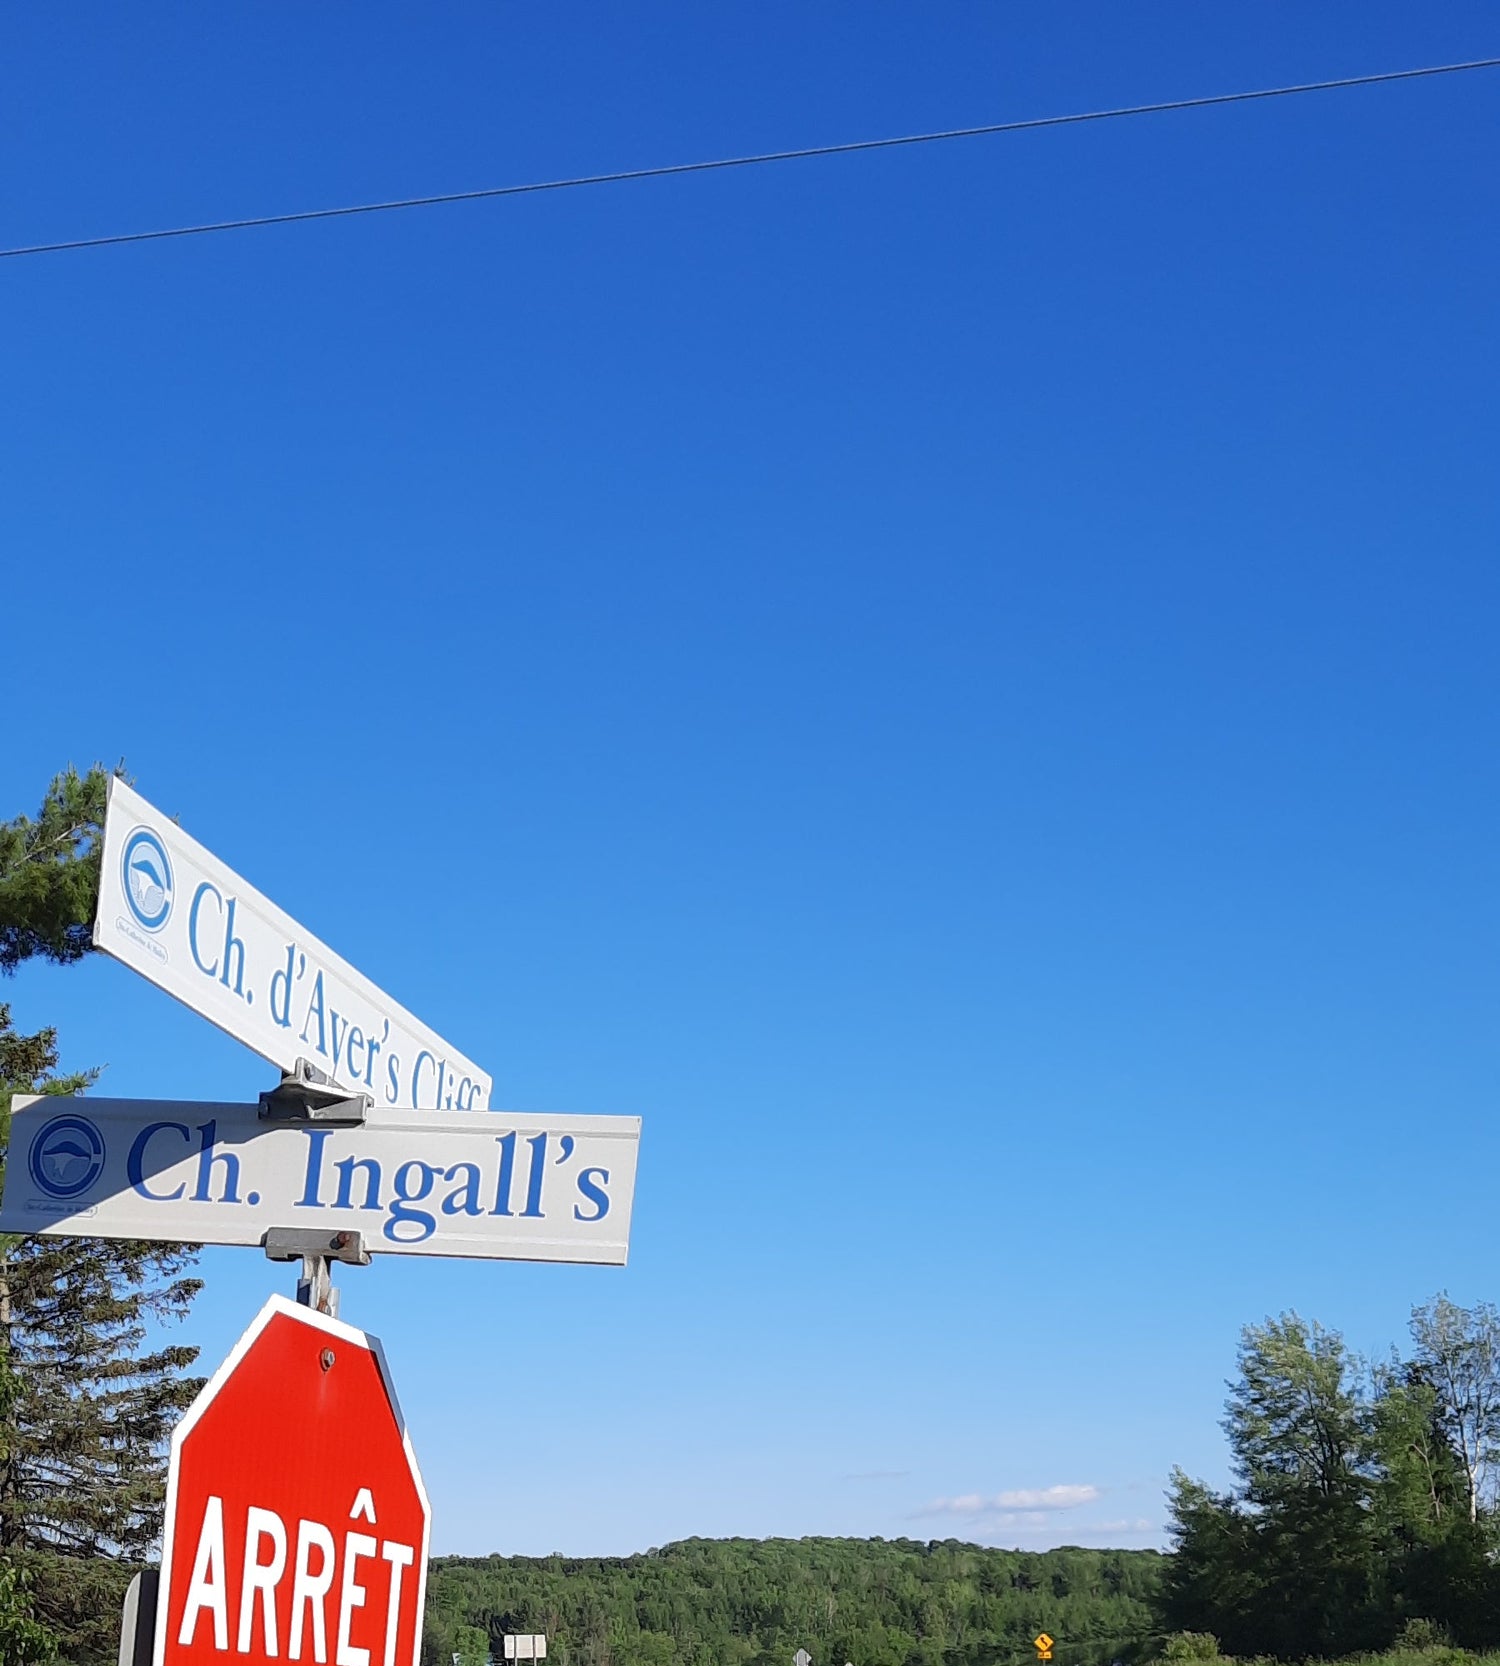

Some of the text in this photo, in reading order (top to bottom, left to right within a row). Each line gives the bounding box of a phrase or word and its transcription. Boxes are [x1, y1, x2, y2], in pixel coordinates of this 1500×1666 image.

[189, 881, 254, 1006] Ch.
[270, 943, 400, 1104] d'Ayer's
[127, 1119, 611, 1242] Ch. Ingall's
